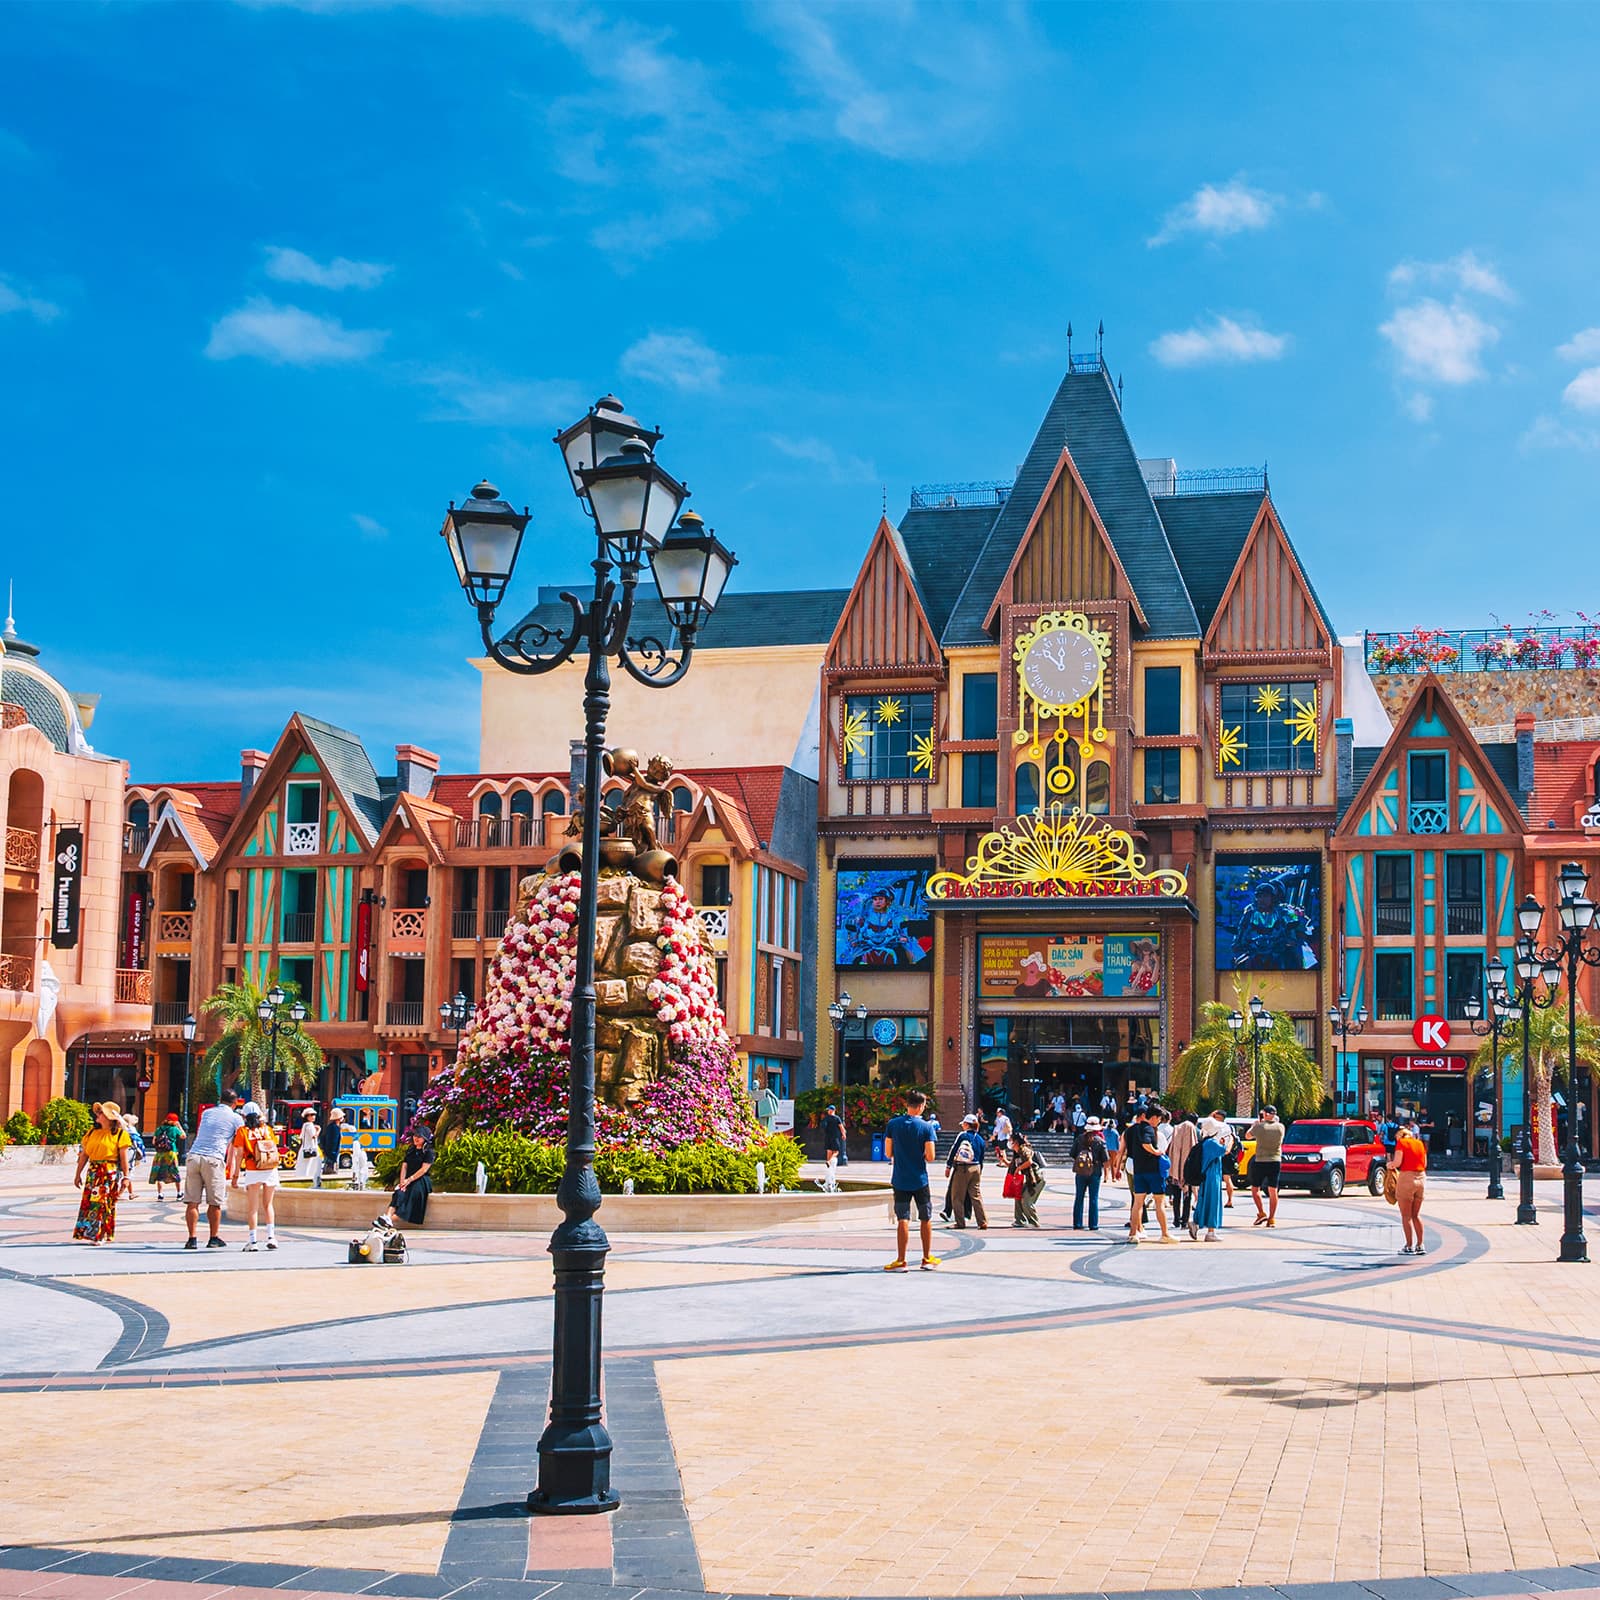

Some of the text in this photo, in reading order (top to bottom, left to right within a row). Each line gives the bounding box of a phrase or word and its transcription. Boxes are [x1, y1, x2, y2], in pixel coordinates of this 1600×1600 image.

[944, 879, 1165, 899] HARBOUR MARKET
[56, 876, 73, 934] hummel
[1106, 956, 1132, 967] TRANG
[1422, 1021, 1448, 1049] K
